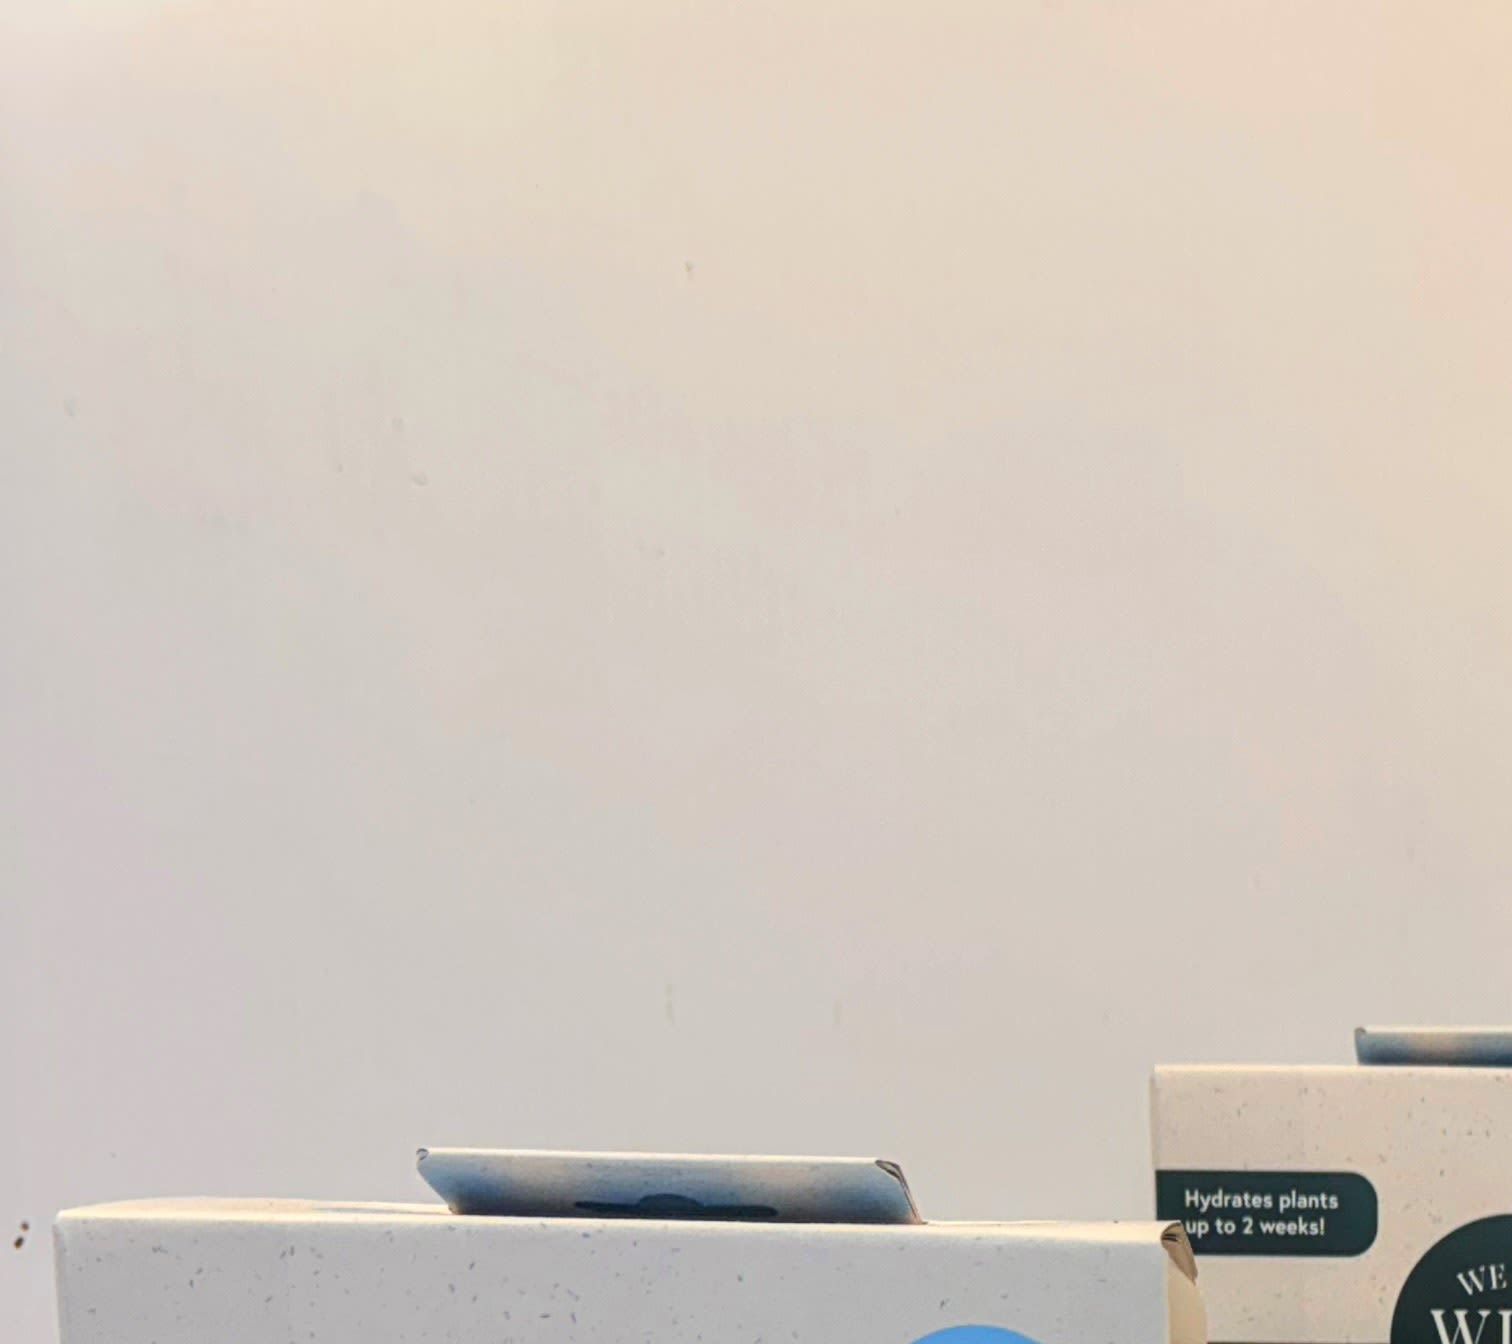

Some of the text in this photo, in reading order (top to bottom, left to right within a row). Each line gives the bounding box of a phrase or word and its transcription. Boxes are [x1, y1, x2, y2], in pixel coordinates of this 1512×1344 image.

[1185, 1190, 1338, 1213] Hydrates plants
[1186, 1217, 1325, 1238] up to 2 weeks!
[1457, 1264, 1507, 1295] WE
